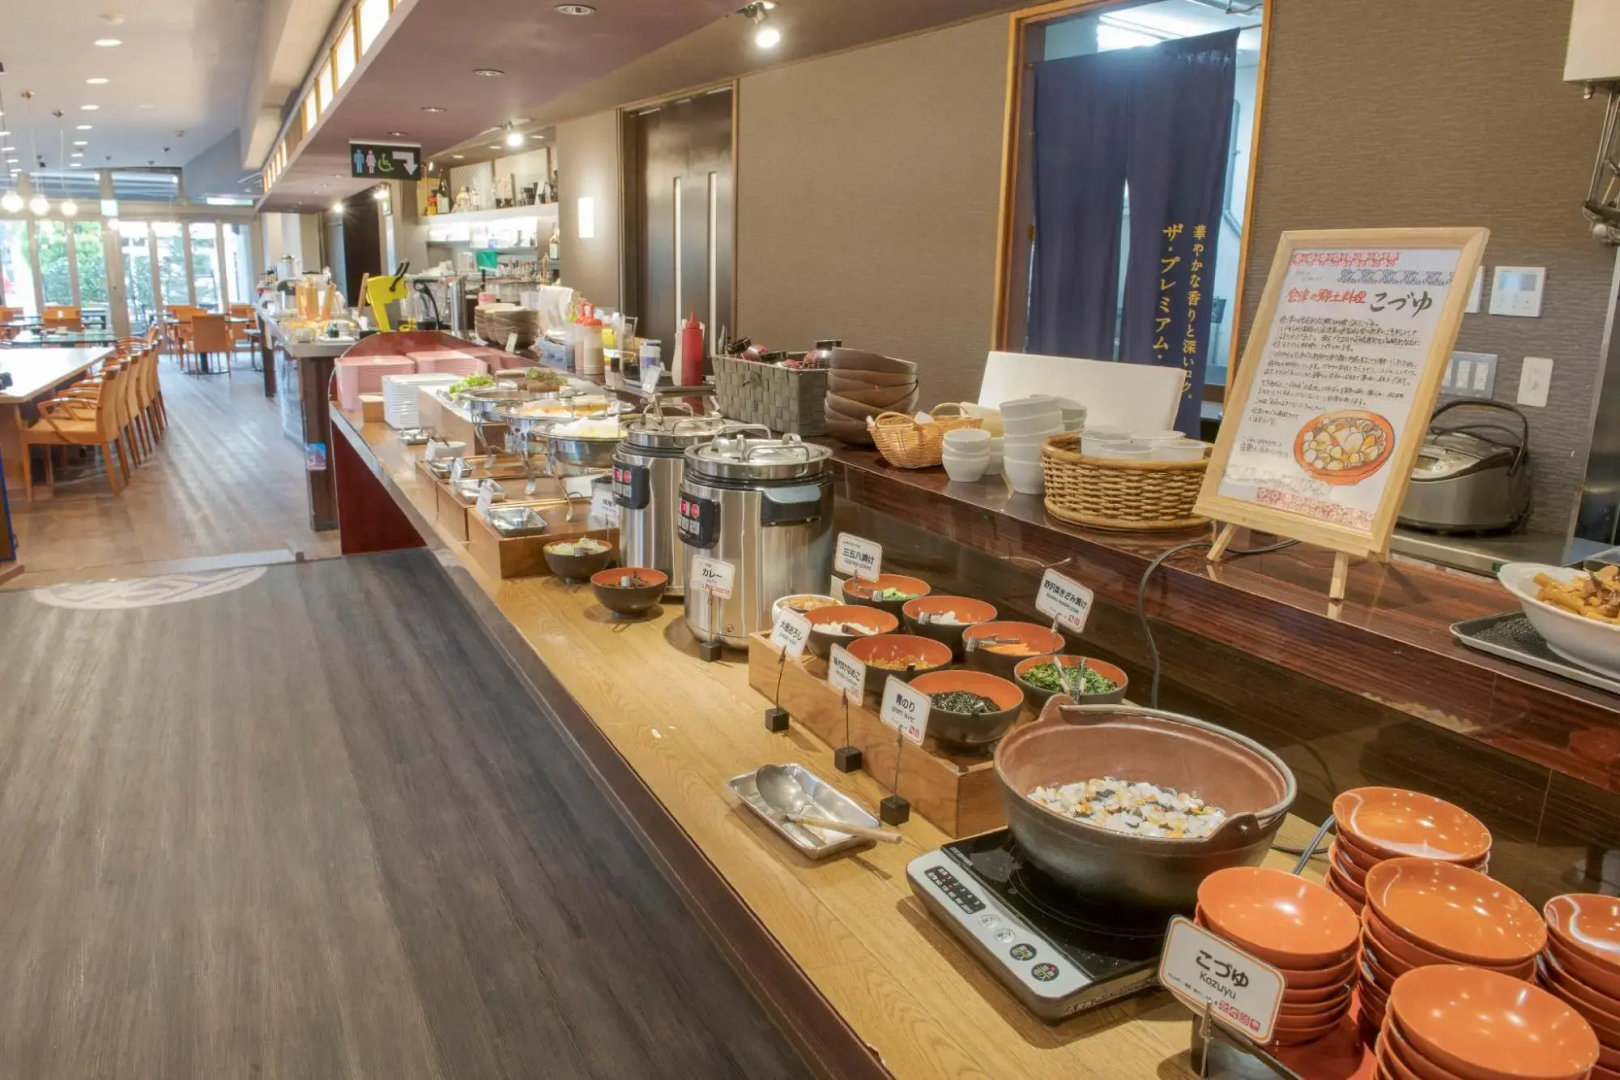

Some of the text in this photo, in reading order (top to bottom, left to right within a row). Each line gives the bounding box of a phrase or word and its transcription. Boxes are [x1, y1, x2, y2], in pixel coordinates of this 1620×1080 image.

[1370, 291, 1433, 318] こづゆ
[702, 568, 722, 578] カレー
[895, 693, 915, 712] 青のり
[1195, 949, 1249, 988] こづゆ
